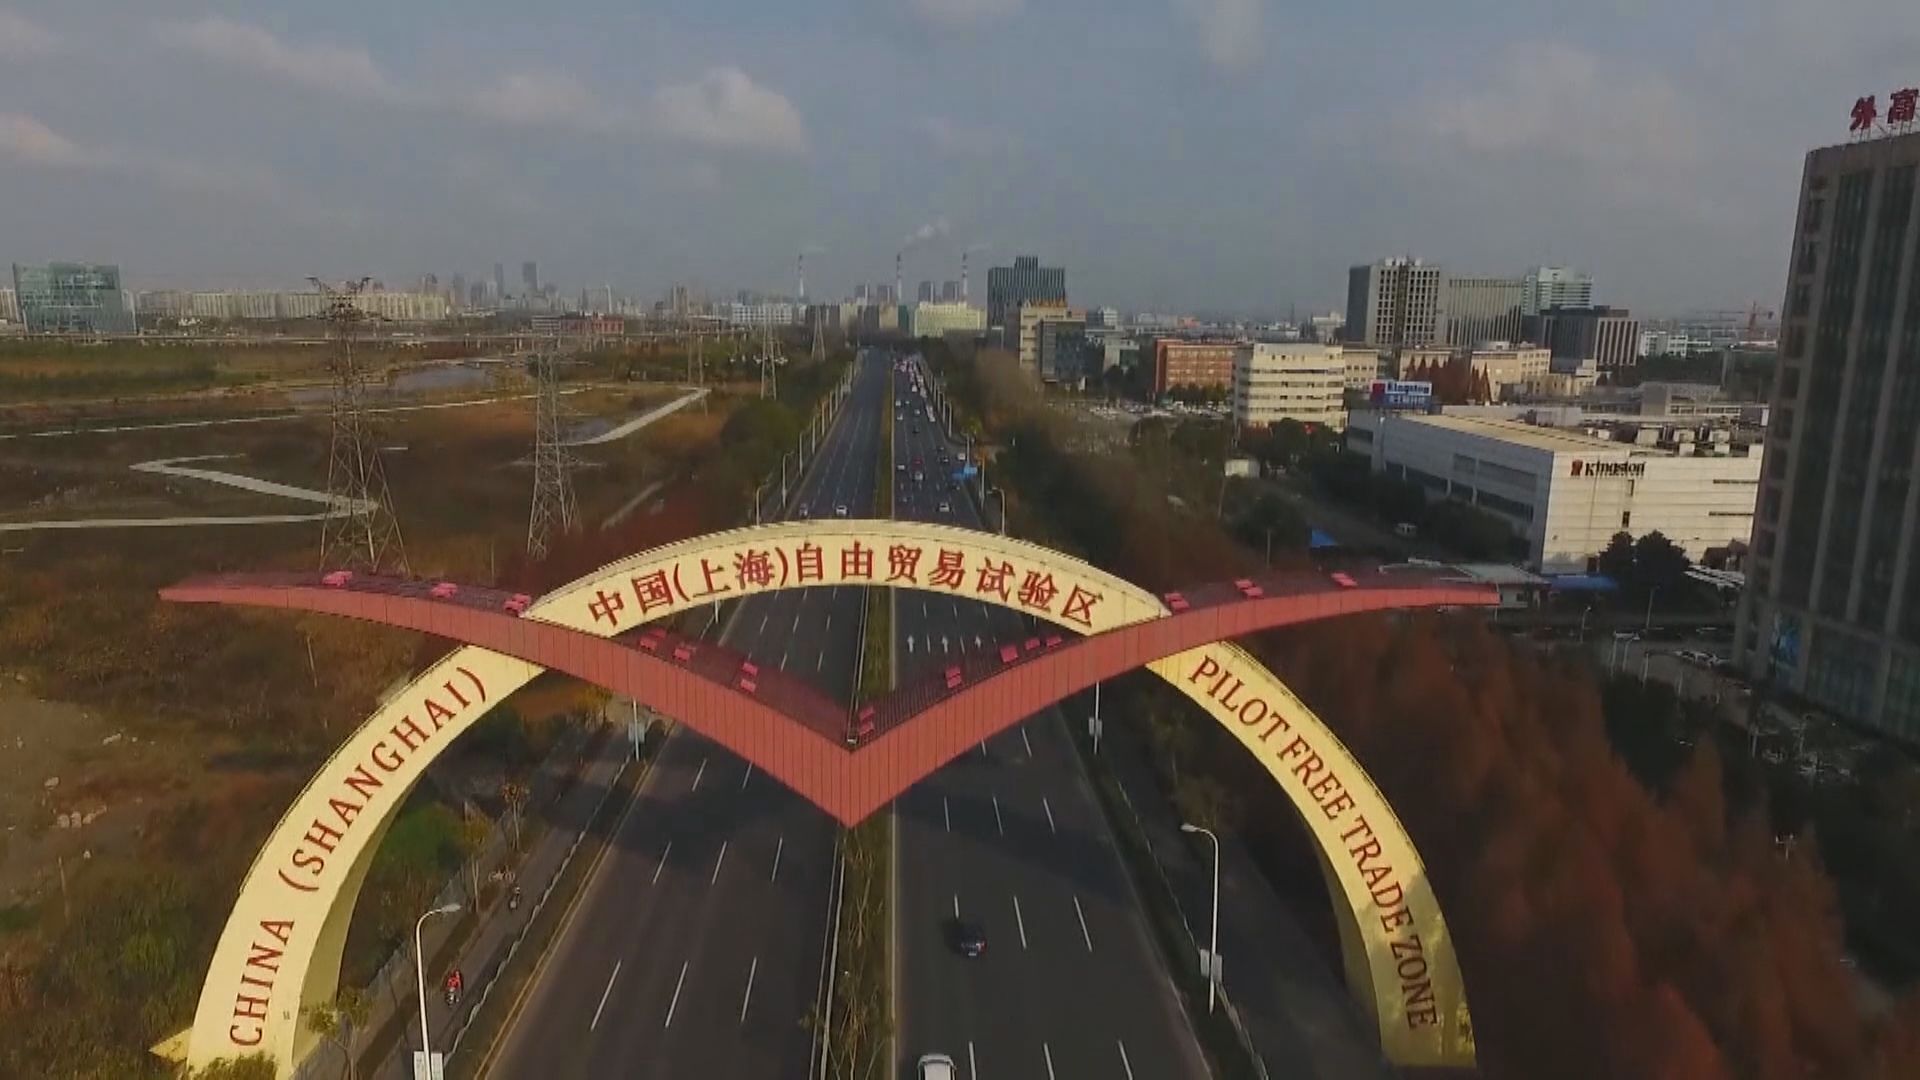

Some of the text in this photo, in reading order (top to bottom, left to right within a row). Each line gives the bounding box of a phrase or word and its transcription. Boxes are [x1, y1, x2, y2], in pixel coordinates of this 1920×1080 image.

[1585, 460, 1647, 477] Kingston
[588, 541, 1105, 628] 中国(上海)自由贸易试验区
[229, 666, 487, 1047] CHINA (SHANGHAI)
[1188, 655, 1438, 1030] PILOT FREE TRADE ZONE
